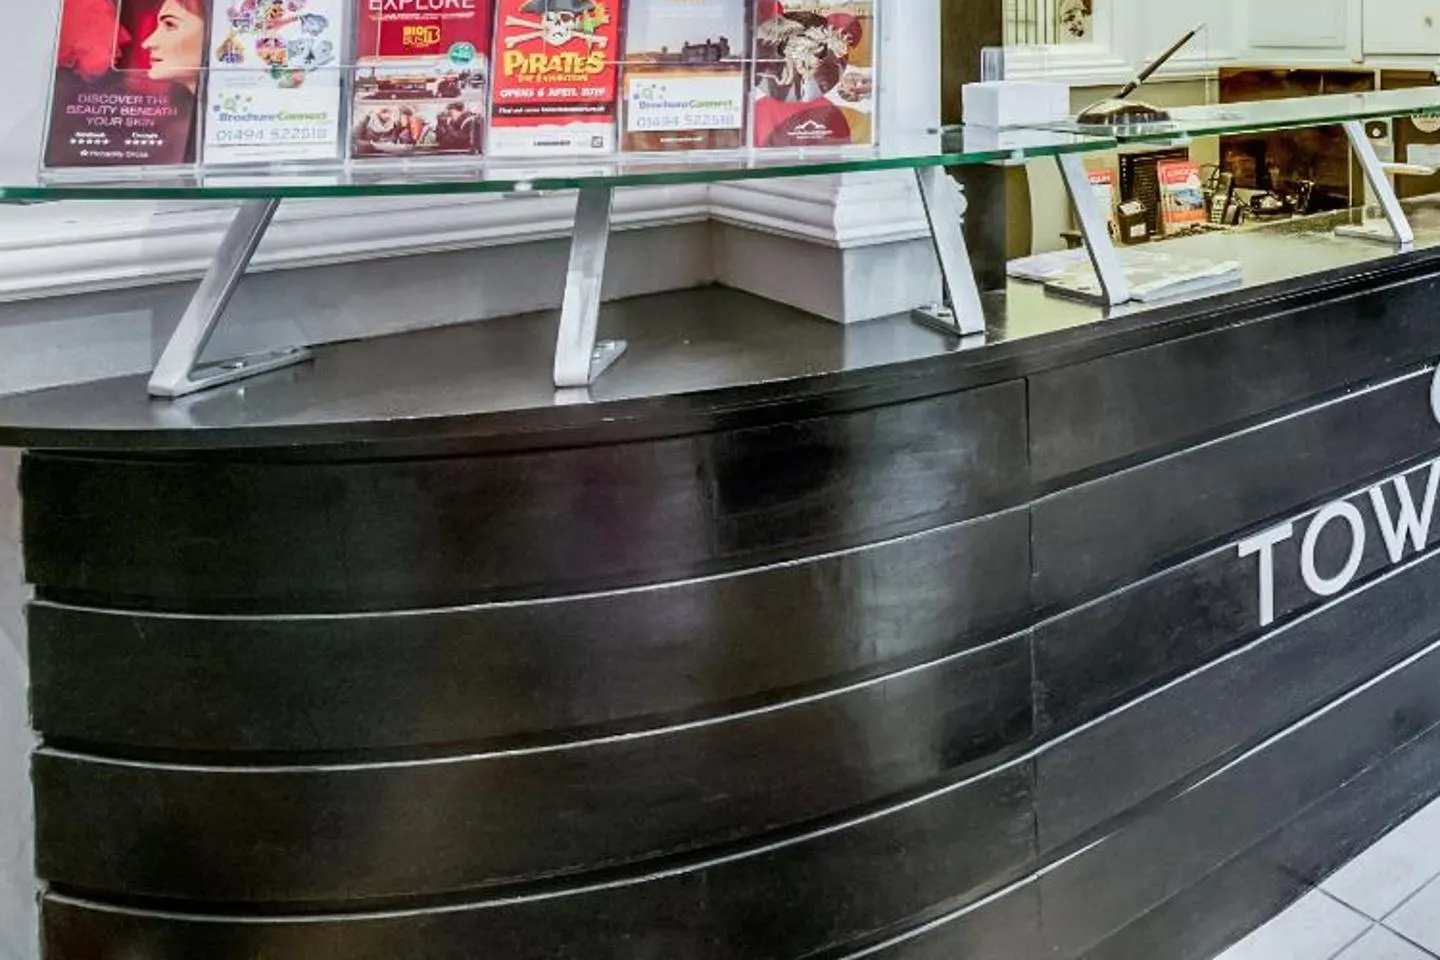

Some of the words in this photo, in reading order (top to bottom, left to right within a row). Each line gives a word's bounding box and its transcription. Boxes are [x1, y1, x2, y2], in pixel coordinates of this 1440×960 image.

[78, 93, 143, 105] DISCOVER
[66, 104, 117, 115] BEAUTY
[120, 105, 178, 116] BENEATH
[86, 116, 123, 126] YOUR
